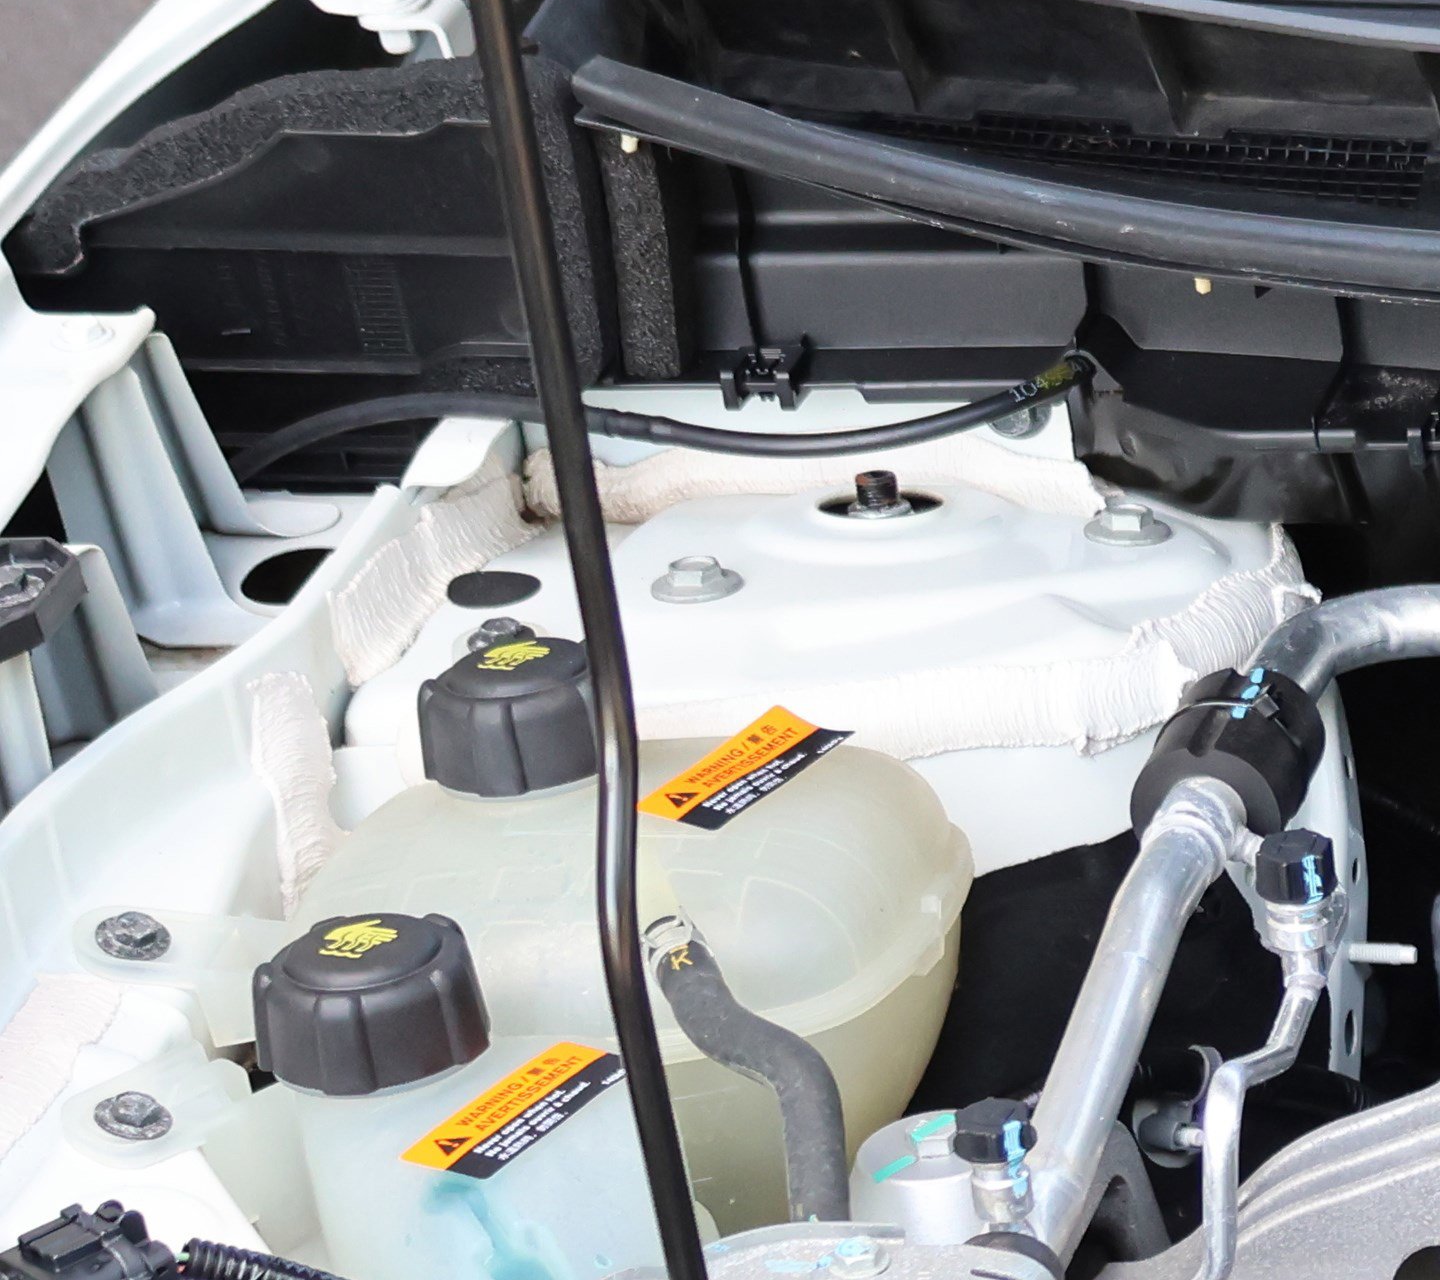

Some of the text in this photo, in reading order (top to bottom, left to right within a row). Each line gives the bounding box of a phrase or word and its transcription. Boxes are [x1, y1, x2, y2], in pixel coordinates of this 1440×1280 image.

[686, 747, 744, 785] WARNING
[702, 726, 800, 788] AVERTISSEMENT
[456, 1081, 524, 1127] WARNING
[475, 1055, 582, 1132] AVERTISSEMENT
